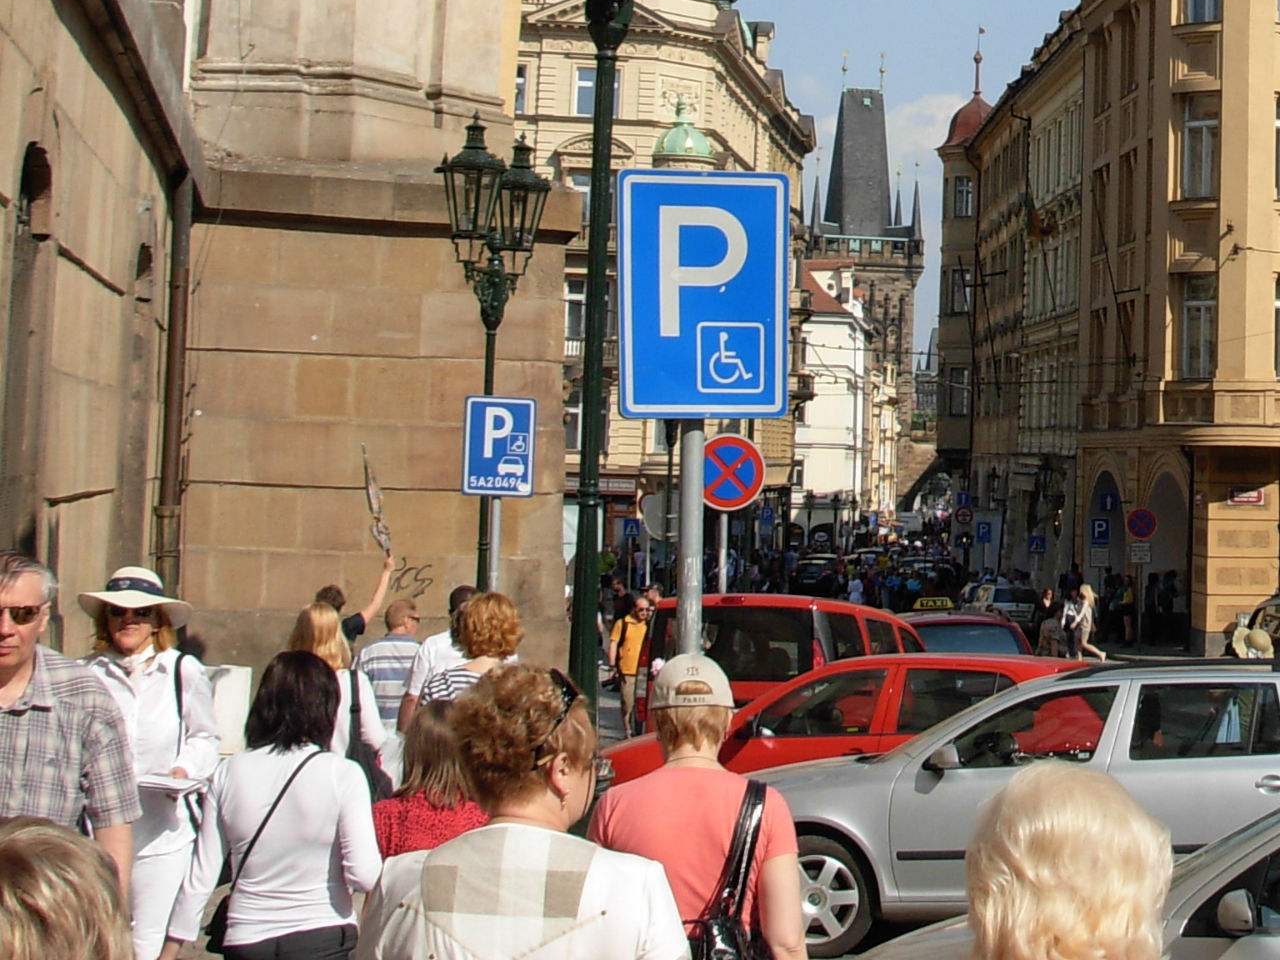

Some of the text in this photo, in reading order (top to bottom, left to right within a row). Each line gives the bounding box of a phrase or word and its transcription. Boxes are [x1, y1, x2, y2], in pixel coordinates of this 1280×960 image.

[659, 205, 748, 337] P
[483, 406, 514, 458] P
[979, 522, 988, 536] P
[1094, 521, 1106, 538] P
[920, 598, 948, 608] TAXI
